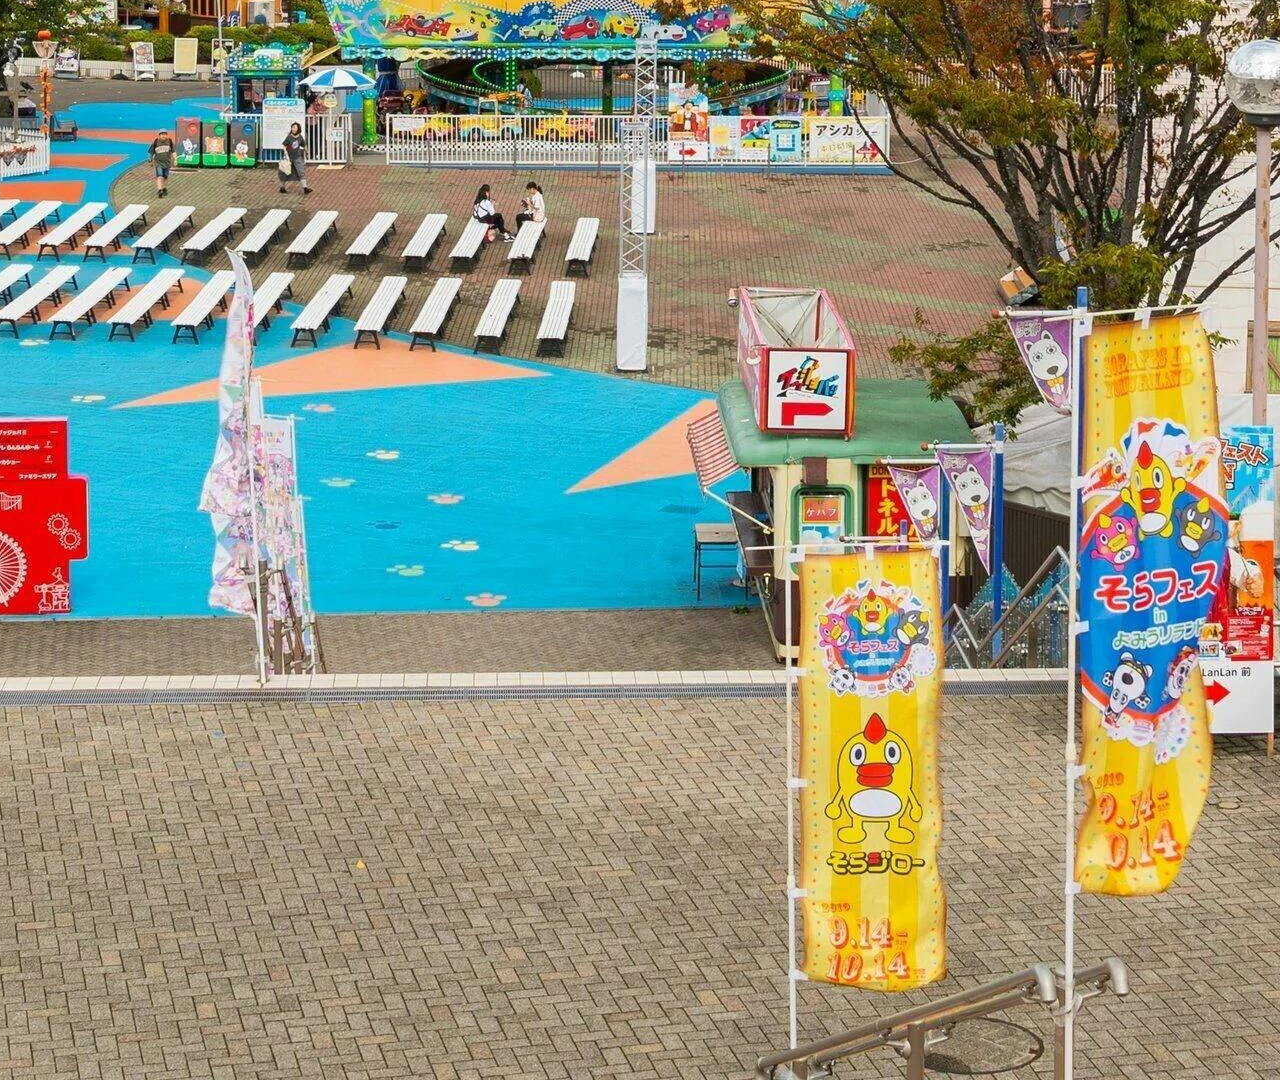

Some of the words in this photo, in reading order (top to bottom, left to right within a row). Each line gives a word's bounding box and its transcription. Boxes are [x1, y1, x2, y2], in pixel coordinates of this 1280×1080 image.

[815, 124, 879, 137] アシカシー
[1093, 560, 1219, 613] そらフェス
[1153, 606, 1168, 625] in
[1201, 667, 1238, 677] LanLan
[1105, 819, 1184, 872] 0.14
[826, 850, 926, 876] そらジロー
